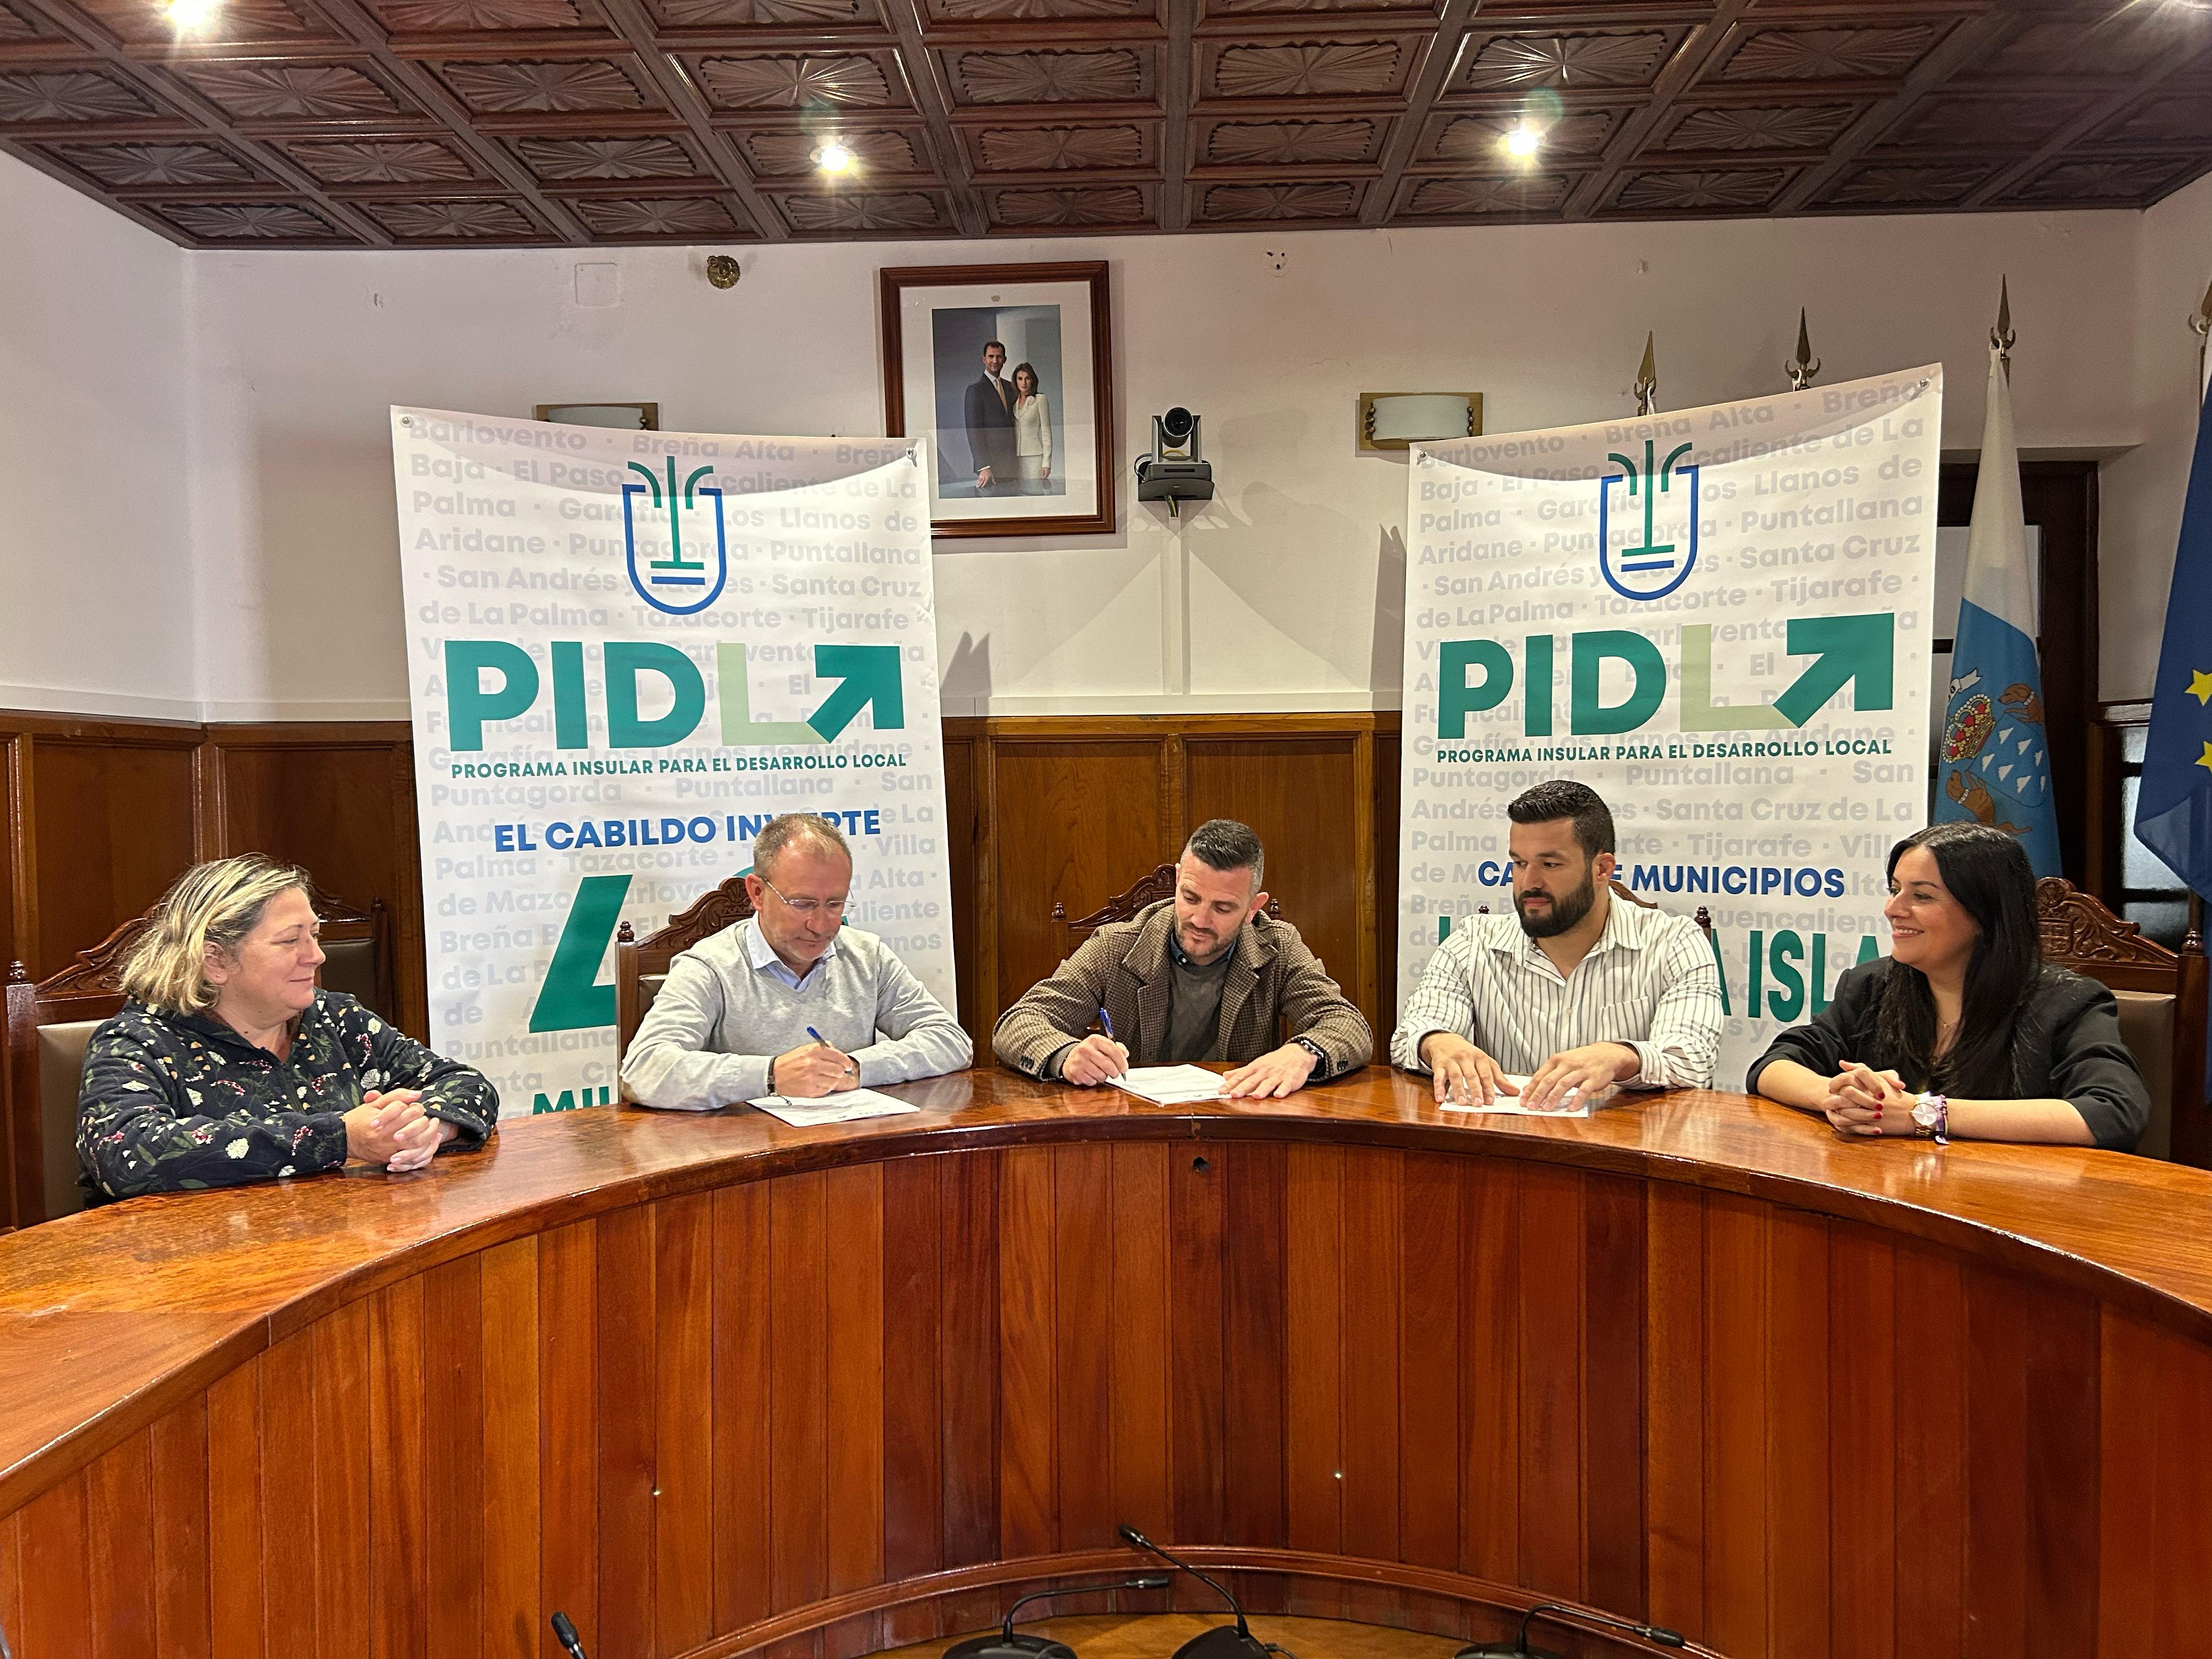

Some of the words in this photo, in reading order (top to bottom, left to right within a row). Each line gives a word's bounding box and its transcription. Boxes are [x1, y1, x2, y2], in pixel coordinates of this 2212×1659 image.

[410, 417, 586, 449] Barlovento
[633, 434, 718, 457] Breña
[735, 441, 794, 461] Alta
[1420, 436, 1565, 469] Barlovento
[1605, 418, 1692, 444] Breña
[1709, 404, 1774, 430] Alta
[411, 454, 484, 483] Baja
[514, 460, 538, 482] El
[550, 462, 624, 486] Paso
[845, 477, 879, 496] de
[885, 479, 916, 498] La
[1420, 477, 1478, 503] Baja
[1503, 470, 1522, 492] El
[1833, 424, 1874, 449] de
[1883, 417, 1922, 441] La
[414, 491, 516, 517] Palma
[781, 508, 870, 529] Llanos
[884, 511, 917, 531] de
[1420, 509, 1500, 533] Palma
[1755, 465, 1859, 495] Llanos
[1878, 455, 1922, 479] de
[415, 527, 545, 553] Aridane
[771, 541, 921, 565] Puntallana
[1418, 539, 1523, 565] Aridane
[1741, 496, 1922, 533] Puntallana
[438, 565, 499, 589] San
[506, 567, 617, 590] Andrés
[772, 574, 855, 594] Santa
[861, 576, 922, 597] Cruz
[1434, 575, 1481, 596] San
[1487, 563, 1584, 591] Andrés
[1740, 543, 1835, 569] Santa
[1843, 535, 1920, 559] Cruz
[1416, 608, 1451, 628] de
[1457, 606, 1485, 626] La
[1489, 600, 1572, 624] Palma
[1770, 569, 1902, 606] Tijarafe
[419, 601, 460, 624] de
[469, 603, 504, 624] La
[510, 604, 608, 625] Palma
[802, 608, 909, 634] Tijarafe
[1750, 652, 1773, 676] El
[444, 641, 830, 751] PIDL
[788, 674, 810, 695] El
[1439, 630, 1793, 739] PIDL
[452, 761, 567, 778] PROGRAMA
[573, 760, 653, 775] INSULAR
[659, 758, 708, 773] PARA
[713, 758, 731, 772] EL
[736, 755, 848, 771] DESARROLLO
[853, 754, 907, 767] LOCAL
[1437, 748, 1532, 763] PROGRAMA
[1537, 747, 1610, 761] INSULAR
[1616, 746, 1663, 760] PARA
[1669, 744, 1688, 759] EL
[1693, 741, 1819, 758] DESARROLLO
[1825, 740, 1892, 755] LOCAL
[431, 778, 622, 809] Puntagorda
[676, 772, 833, 798] Puntallana
[881, 771, 932, 791] San
[1627, 762, 1793, 785] Puntallana
[1853, 760, 1914, 784] San
[902, 804, 933, 823] La
[1656, 798, 1742, 821] Santa
[1751, 798, 1821, 821] Cruz
[1828, 798, 1868, 820] de
[1876, 798, 1912, 821] La
[495, 824, 537, 852] EL
[545, 816, 716, 850] CABILDO
[1412, 831, 1497, 851] Palma
[1688, 833, 1812, 860] Tijarafe
[435, 855, 535, 879] Palma
[562, 845, 718, 873] Tazacorte
[874, 834, 935, 856] Villa
[1410, 862, 1446, 883] de
[438, 893, 477, 916] de
[486, 890, 572, 913] Mazo
[868, 867, 924, 889] Alta
[1631, 865, 1844, 898] MUNICIPIOS
[440, 924, 533, 953] Breña
[442, 967, 481, 989] de
[488, 963, 526, 985] La
[444, 1002, 483, 1026] de
